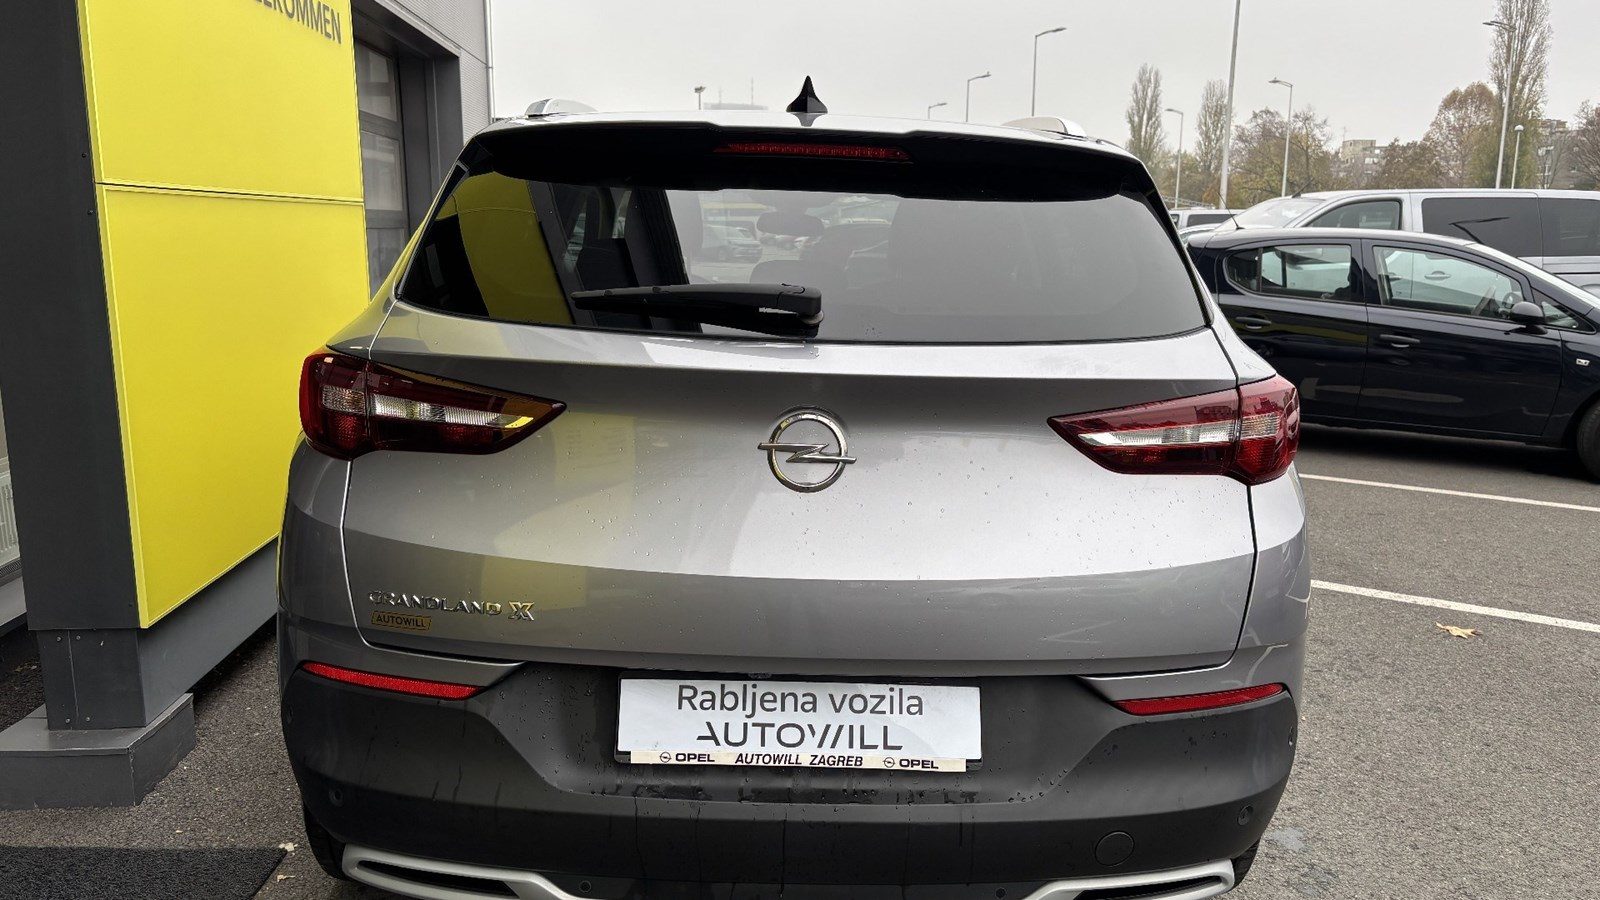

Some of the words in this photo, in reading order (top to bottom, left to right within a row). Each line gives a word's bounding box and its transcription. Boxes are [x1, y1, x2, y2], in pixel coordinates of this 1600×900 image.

[369, 590, 502, 616] GRANDLAND
[508, 601, 535, 621] X
[376, 614, 426, 628] AUTOWILL
[677, 684, 818, 719] Rabljena
[828, 687, 924, 716] vozila
[696, 721, 903, 751] AUTOWILL
[675, 753, 715, 763] OPEL
[735, 753, 803, 766] AUTOWILL
[809, 755, 863, 768] ZAGREB
[899, 758, 939, 769] OPEL
